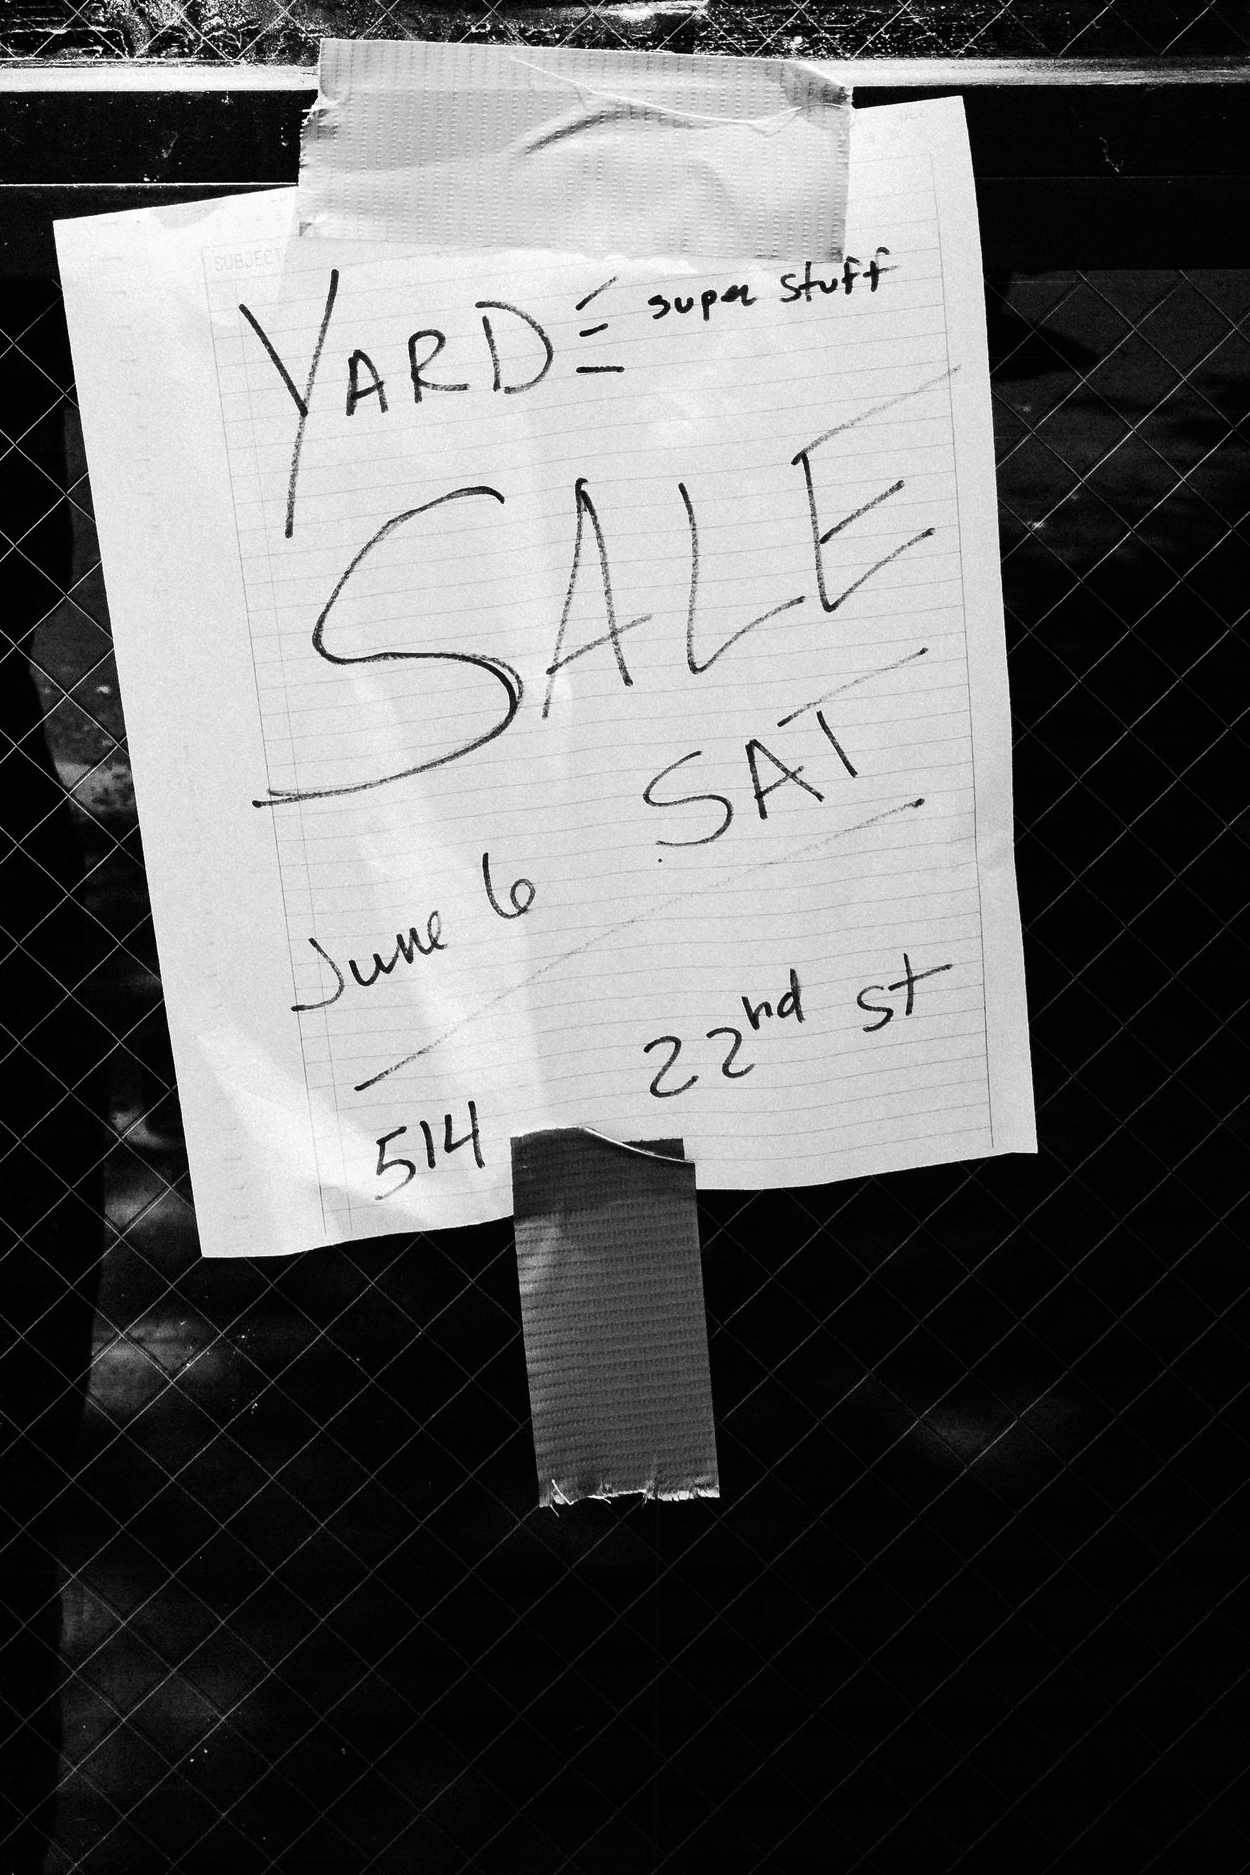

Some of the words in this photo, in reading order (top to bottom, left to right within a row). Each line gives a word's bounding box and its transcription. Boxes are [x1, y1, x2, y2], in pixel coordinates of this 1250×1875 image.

[214, 247, 282, 272] SUBJECT
[647, 283, 755, 321] super
[780, 247, 899, 303] stuff
[239, 269, 553, 537] YARD
[252, 365, 962, 807] SALE
[642, 647, 929, 847] SAT
[291, 910, 447, 1012] June
[481, 853, 536, 918] 6
[376, 1101, 486, 1201] 514
[644, 968, 804, 1098] 22nd
[857, 954, 953, 1032] st
